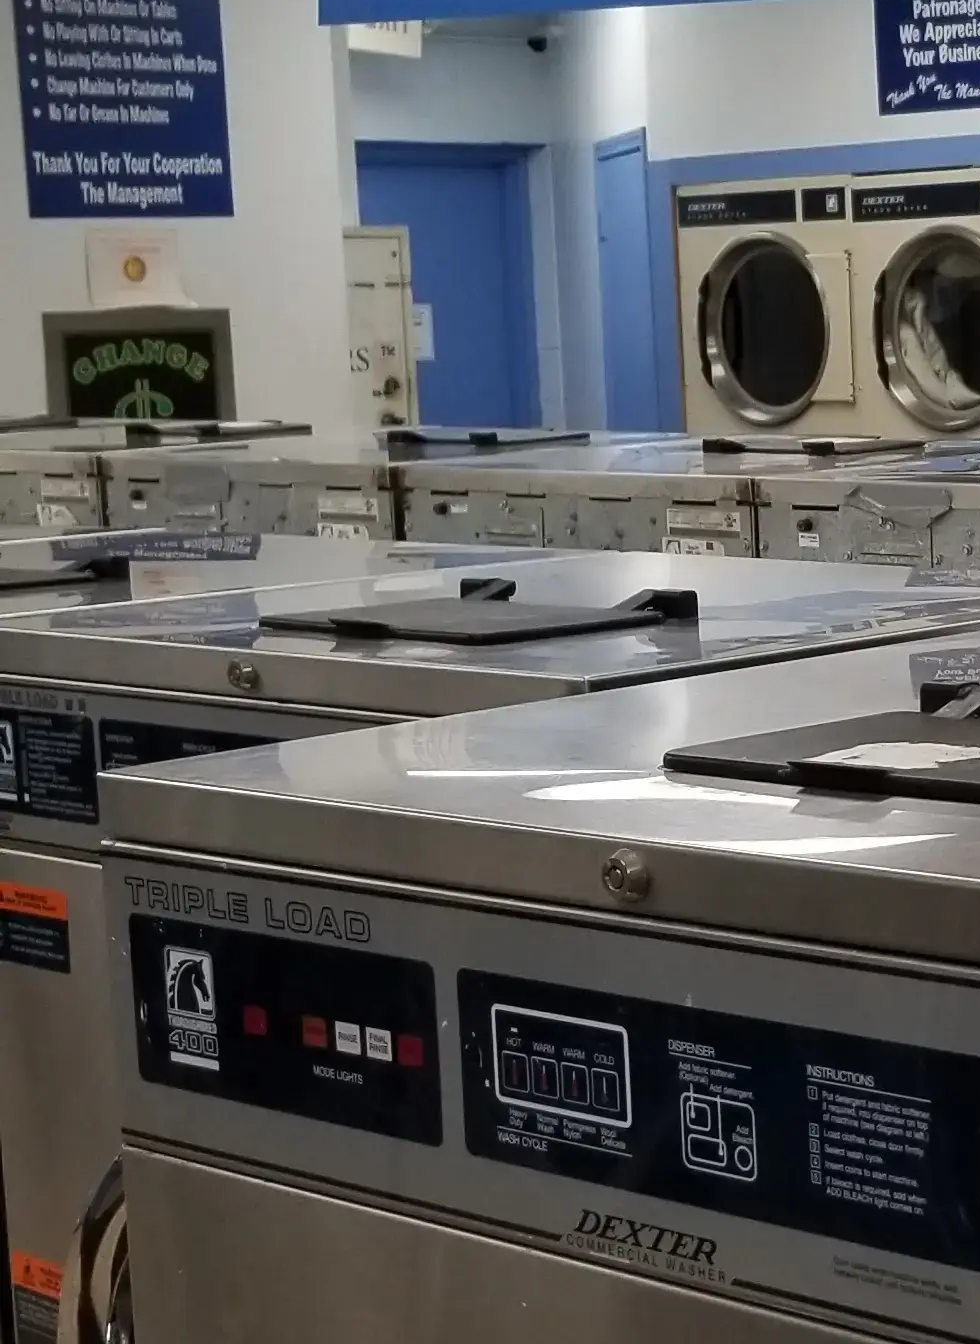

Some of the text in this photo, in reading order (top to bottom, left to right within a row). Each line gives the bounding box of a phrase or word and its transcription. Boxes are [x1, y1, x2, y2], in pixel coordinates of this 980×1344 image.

[899, 24, 920, 44] We
[902, 47, 935, 67] Your
[886, 82, 915, 108] Thank
[916, 73, 938, 93] You
[934, 83, 952, 101] The
[33, 152, 222, 179] Thank You For Your Cooperation
[80, 182, 183, 209] The Management
[862, 195, 905, 206] DEXTER
[73, 338, 210, 385] CHANGE
[124, 877, 372, 943] TRIPLE LOAD
[169, 1029, 219, 1056] 400
[506, 1037, 522, 1046] HOT
[668, 1039, 715, 1058] DISPENSER
[313, 1065, 363, 1085] MODE LIGHTS
[806, 1064, 874, 1087] INSTRUCTIONS
[498, 1131, 548, 1152] WASH CYCLE
[574, 1208, 718, 1265] DEXTER
[566, 1232, 726, 1286] COMMERCIAL WASHER
